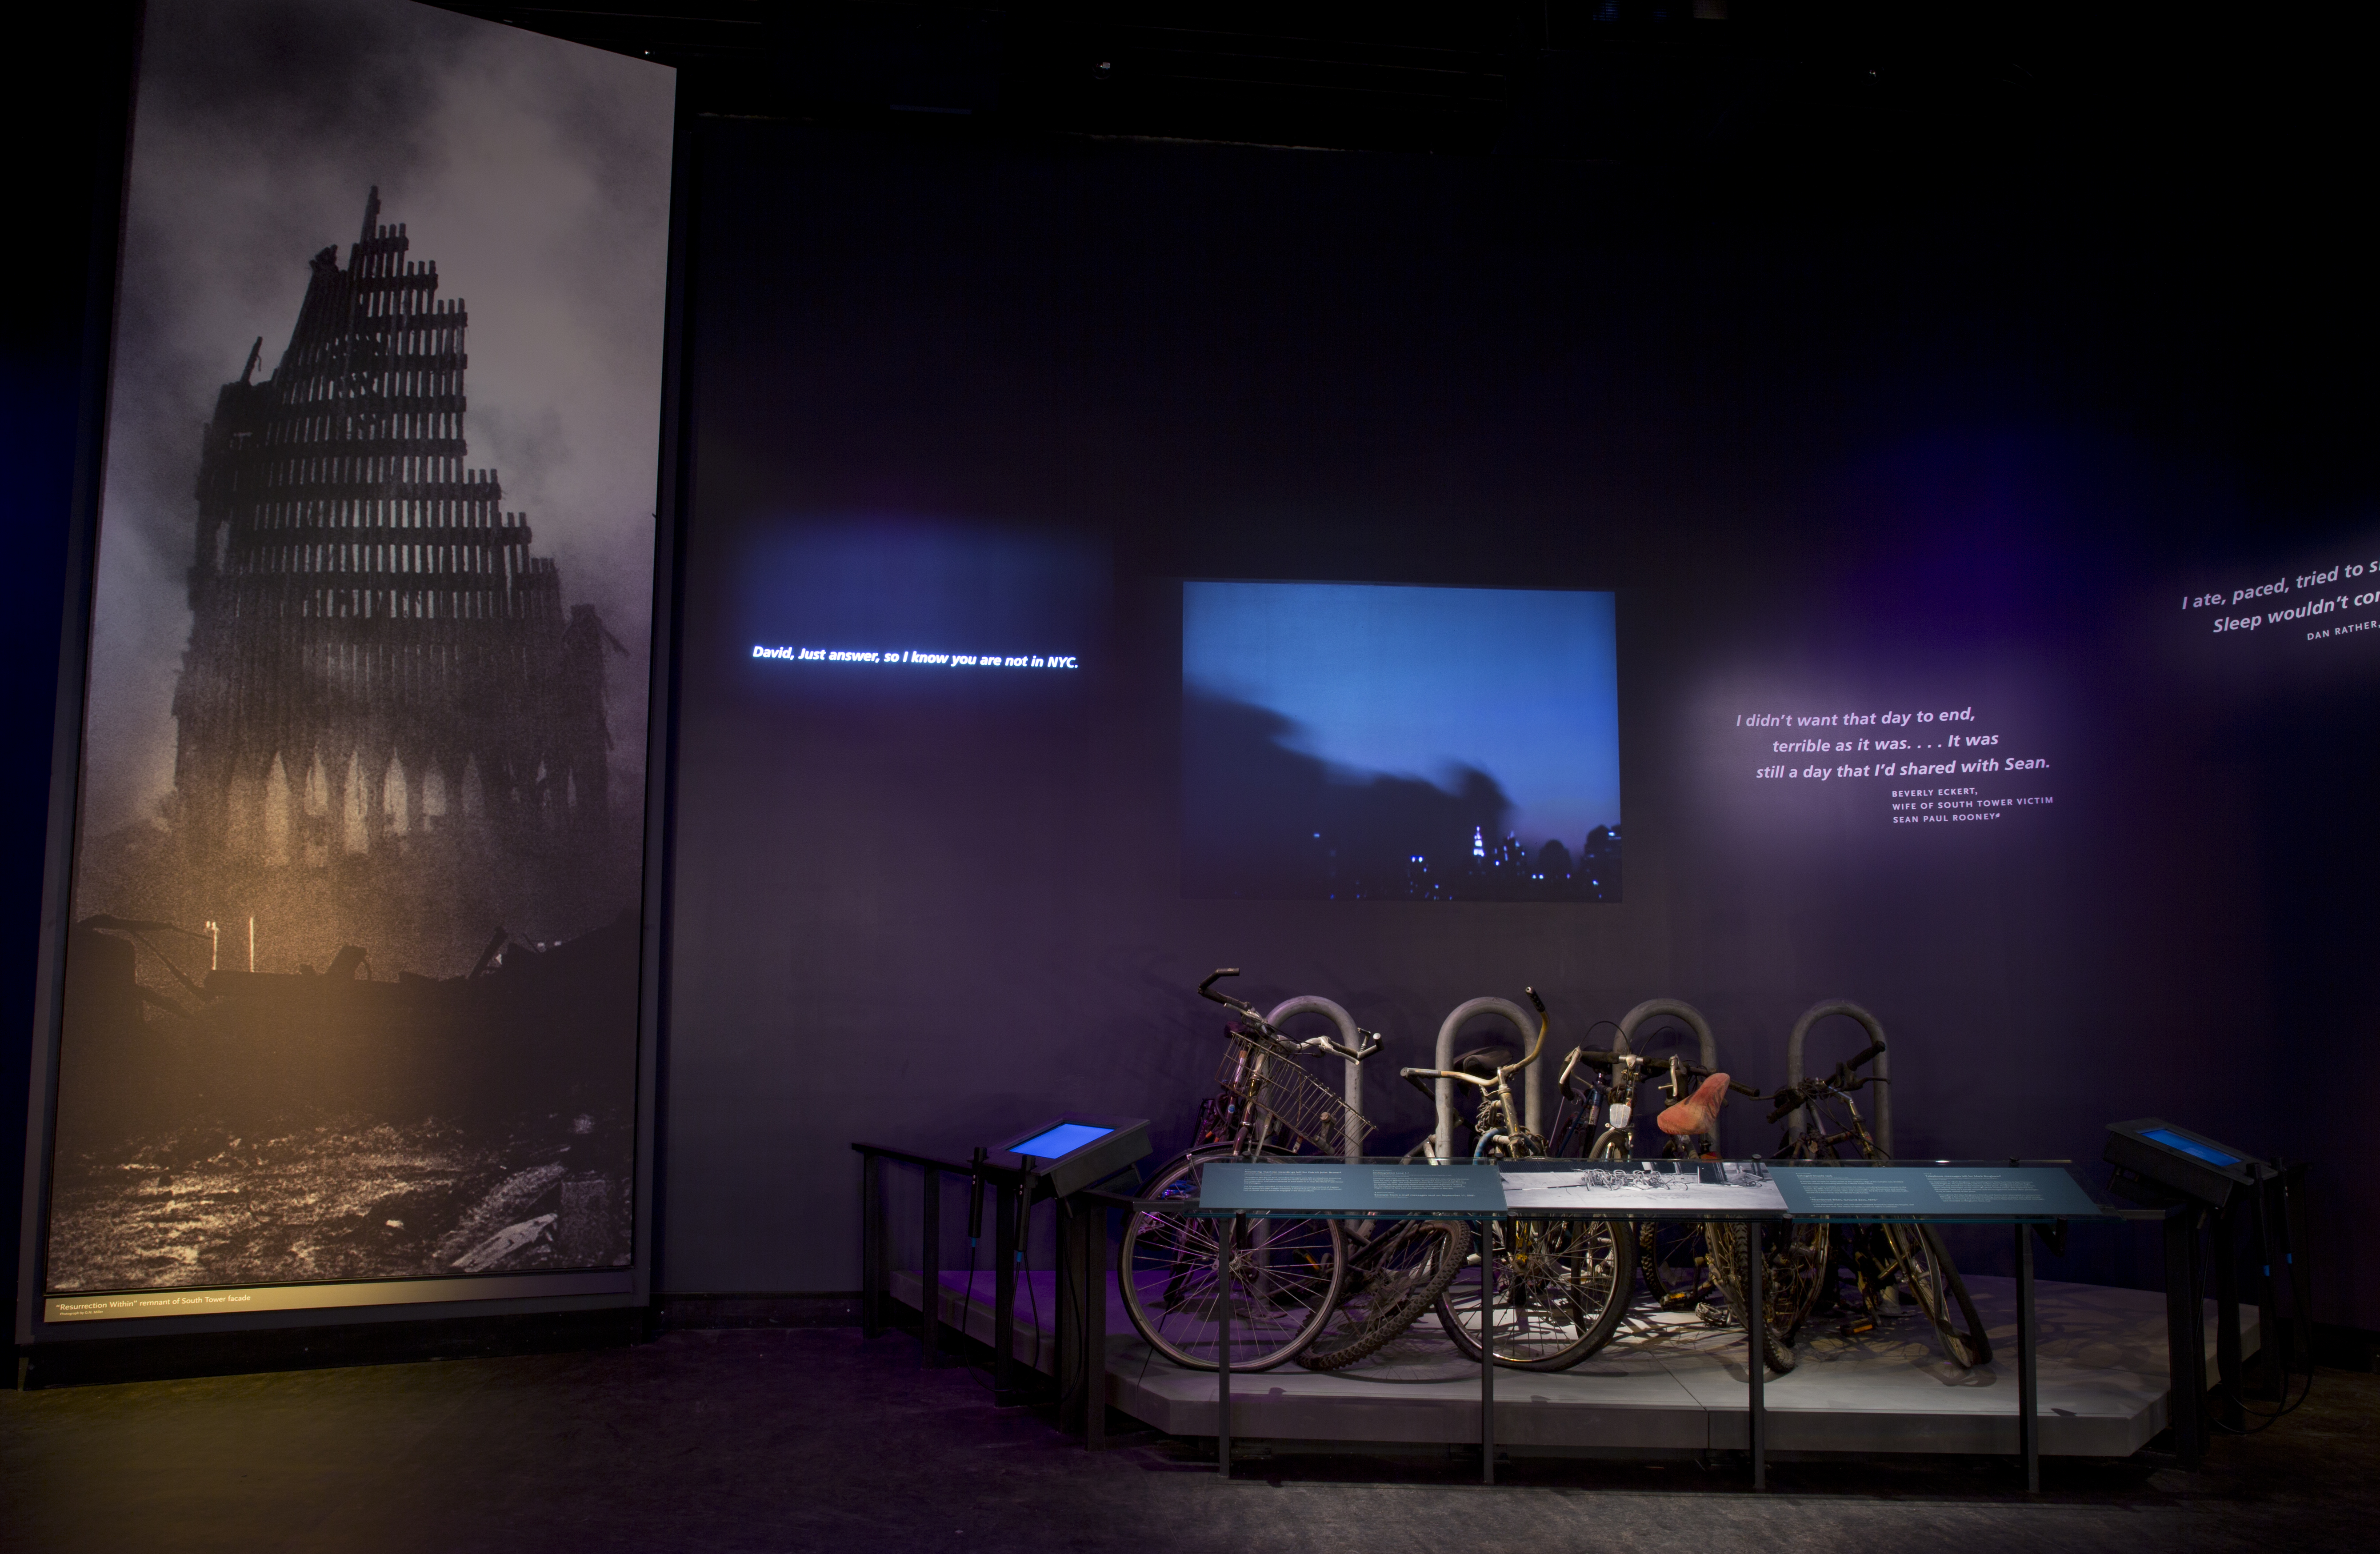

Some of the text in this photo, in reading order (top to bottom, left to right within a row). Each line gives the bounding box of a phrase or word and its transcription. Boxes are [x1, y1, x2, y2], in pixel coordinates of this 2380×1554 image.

[2183, 597, 2188, 609] I
[2193, 594, 2226, 607] ate,
[2233, 578, 2289, 604] paced,
[2296, 566, 2339, 588] tried
[2345, 565, 2363, 578] to
[2213, 616, 2261, 632] Sleep
[2308, 630, 2329, 640] DAN
[753, 646, 1078, 668] David, Just answer, so I know you are not in NYC.
[1737, 715, 1741, 726] I
[1798, 715, 1838, 726] want
[1844, 713, 1876, 725] that
[1882, 711, 1911, 726] day
[1917, 711, 1933, 722] to
[1940, 707, 1974, 721] end,
[1773, 739, 1830, 752] terrible
[1836, 742, 1852, 751] as
[1858, 739, 1869, 751] it
[1948, 735, 1960, 747] It
[1966, 735, 1998, 746] was
[1756, 766, 1784, 778] still
[1789, 769, 1797, 778] a
[1804, 765, 1832, 780] day
[1837, 765, 1870, 777] that
[1900, 760, 1956, 775] shared
[1961, 759, 1998, 772] with
[2005, 758, 2049, 770] Sean.
